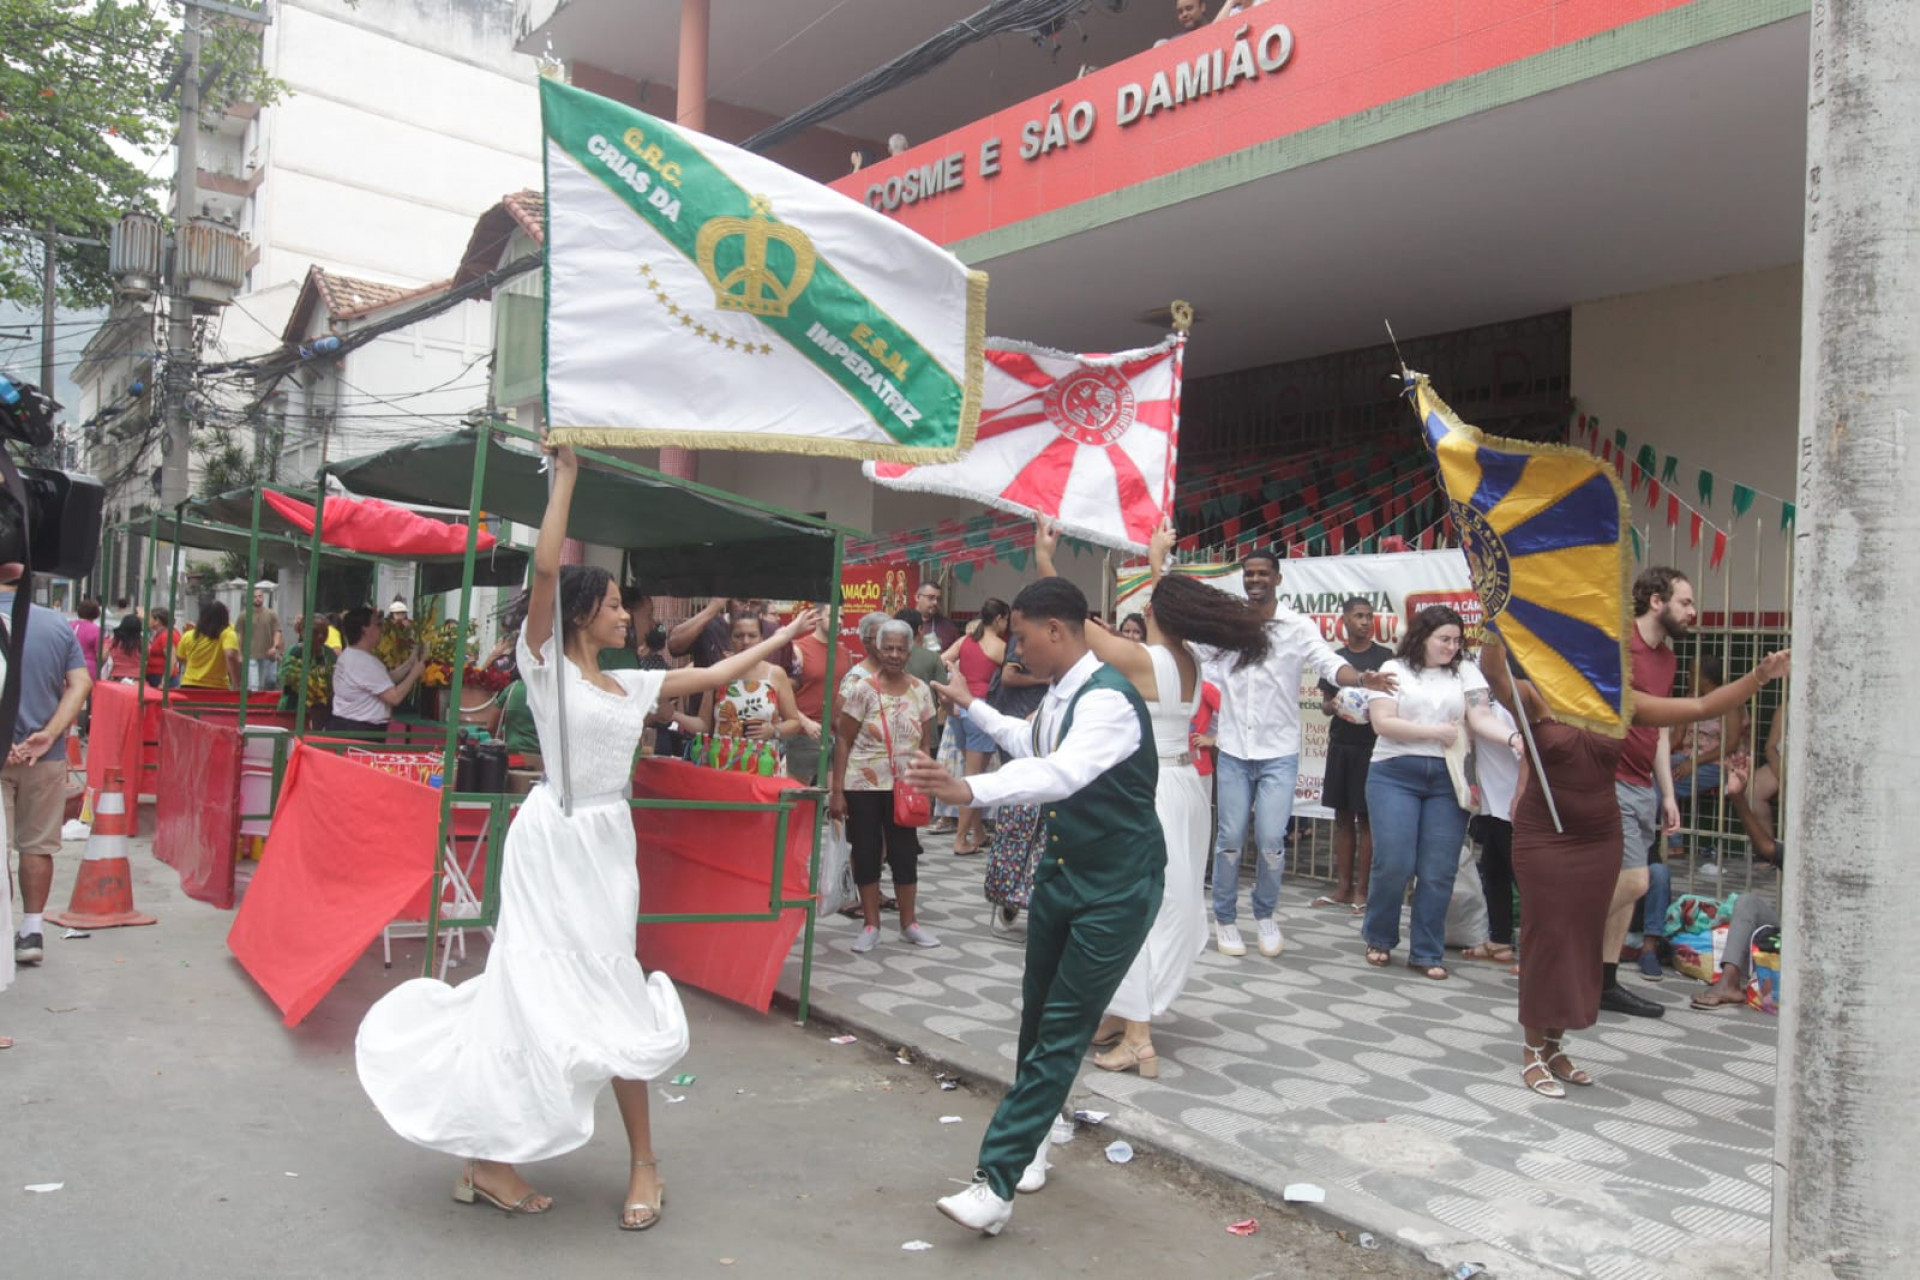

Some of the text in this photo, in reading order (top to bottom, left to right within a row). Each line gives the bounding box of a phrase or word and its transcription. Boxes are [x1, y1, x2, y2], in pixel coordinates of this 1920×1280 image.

[865, 23, 1297, 212] COSME E SÃO DAMIÃO
[587, 134, 682, 223] CRIAS DA
[806, 321, 922, 429] IMPERATRIZ
